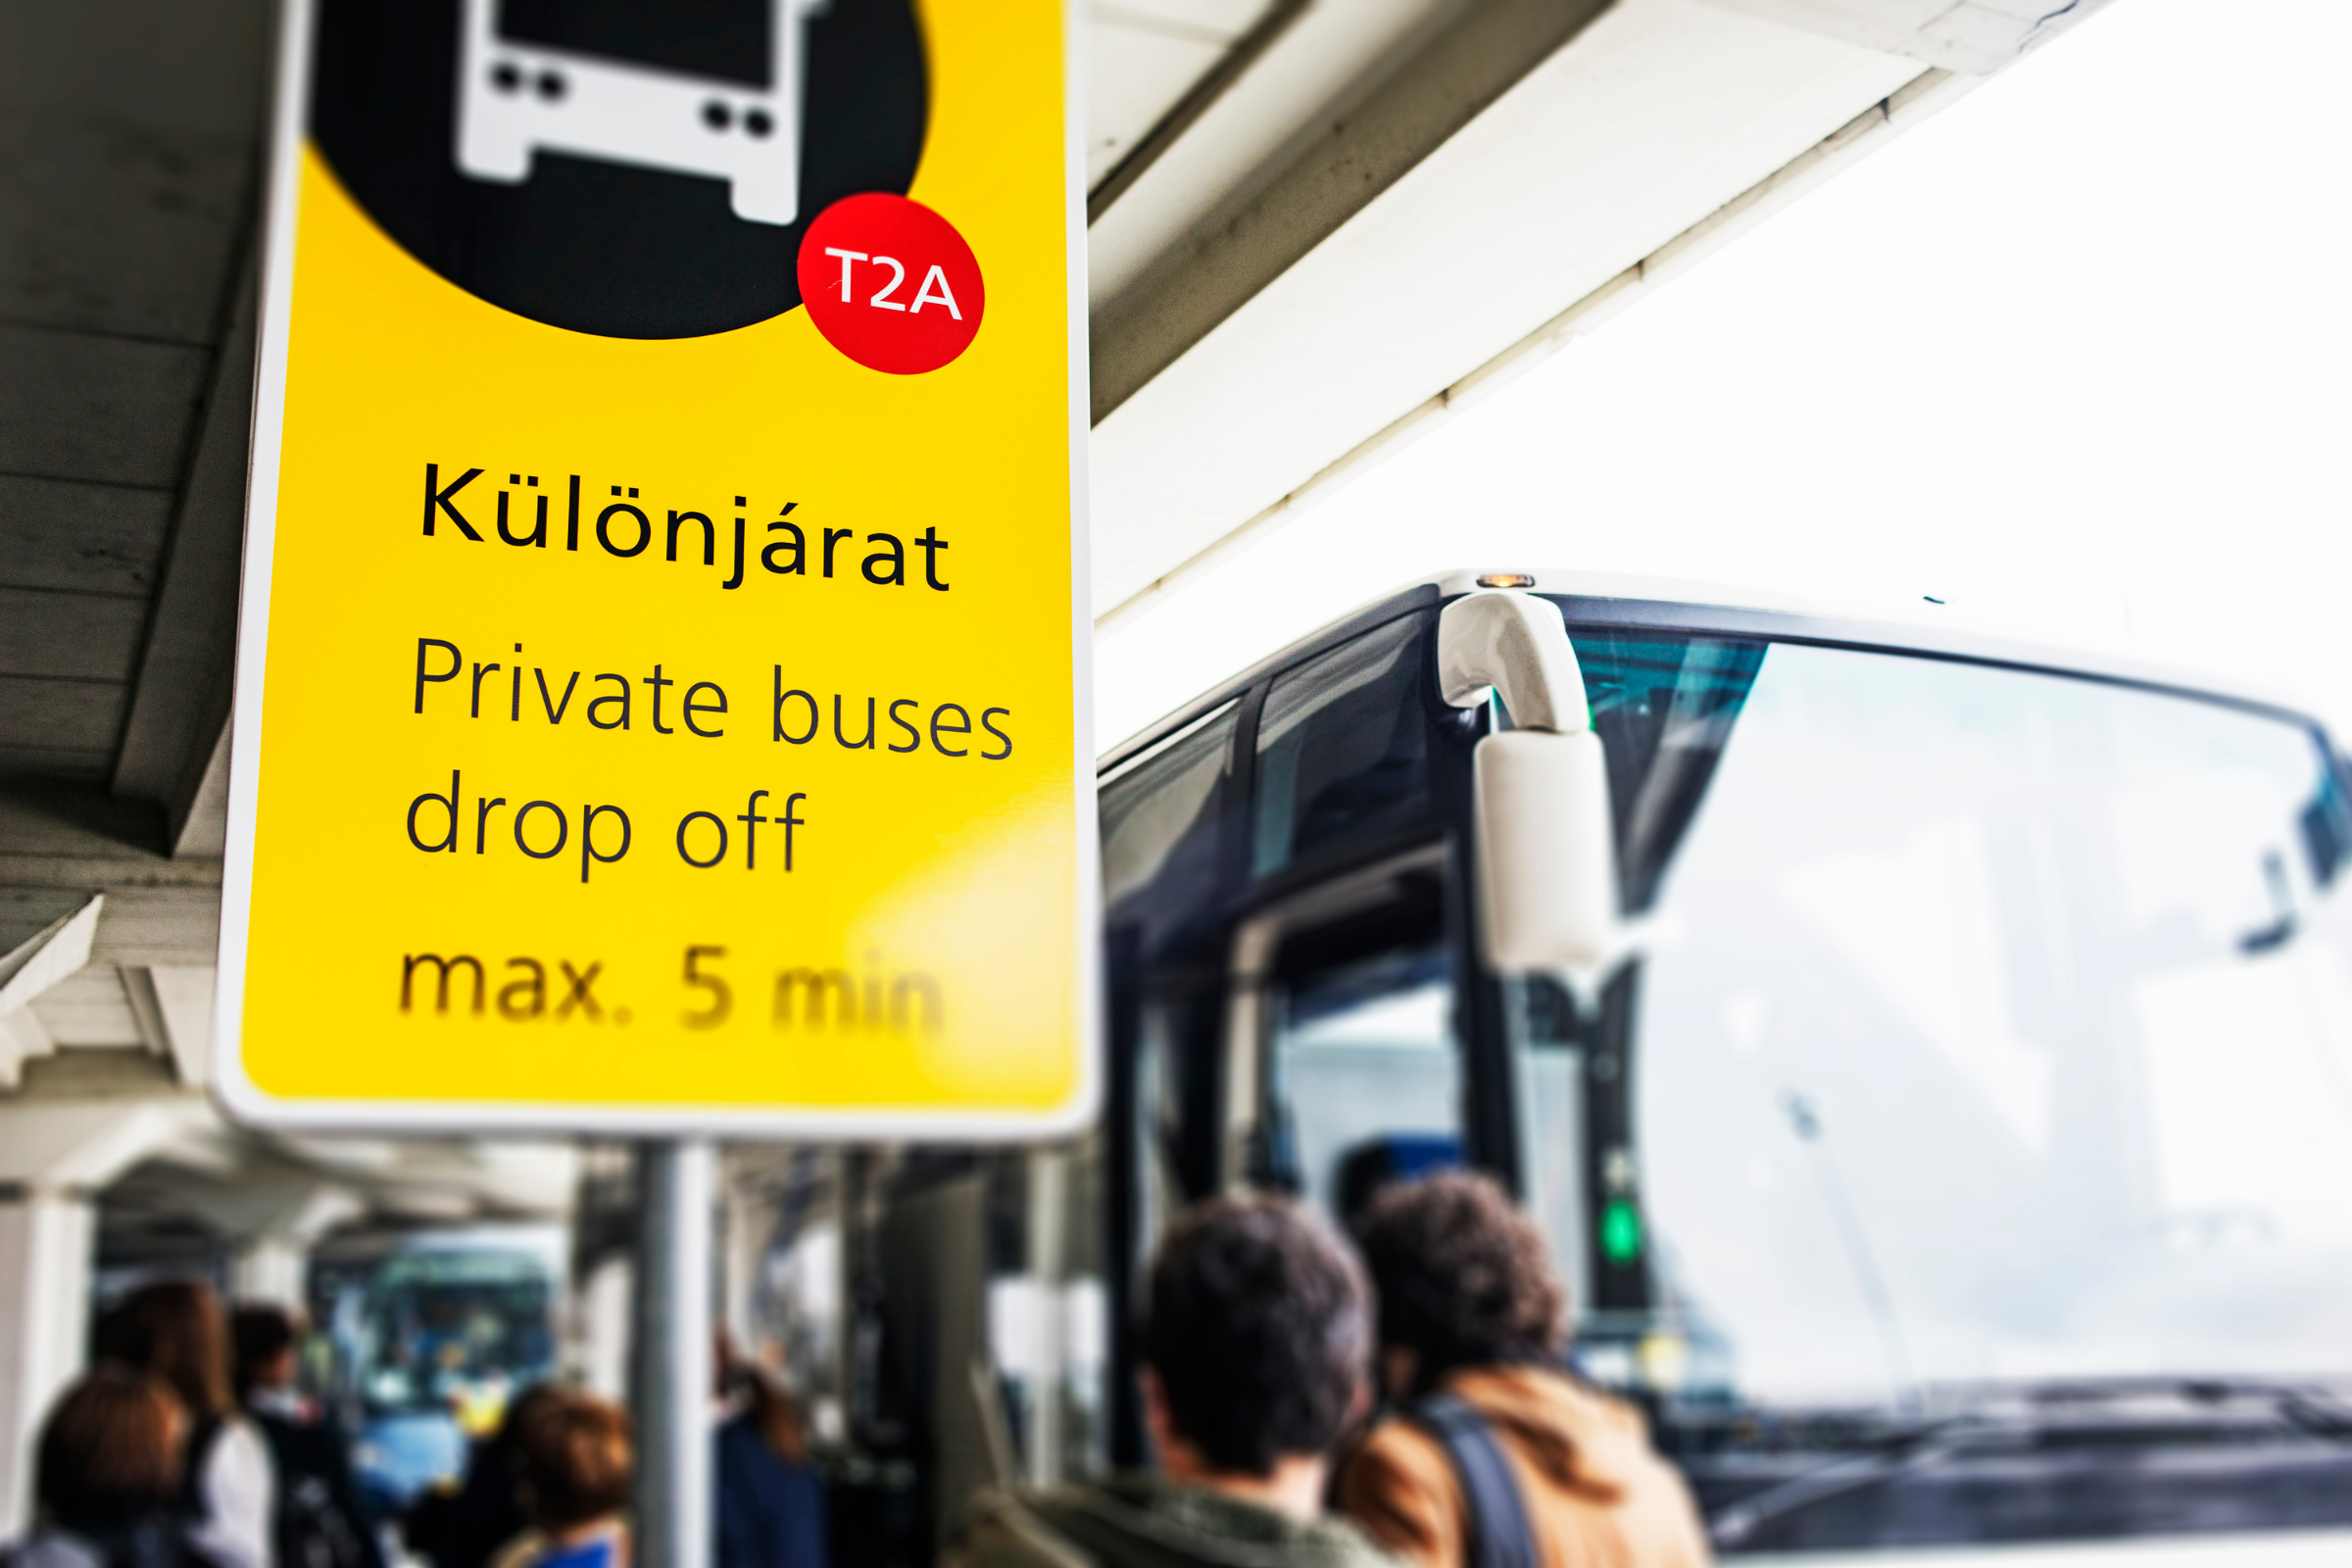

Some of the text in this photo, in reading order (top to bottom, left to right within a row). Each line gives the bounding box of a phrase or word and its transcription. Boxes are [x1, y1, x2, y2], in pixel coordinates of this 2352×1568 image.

[824, 247, 962, 321] T2A
[423, 464, 949, 591] Különjárat
[415, 638, 1011, 760] Private buses
[408, 770, 806, 883] drop off
[397, 945, 943, 1035] max. 5 min
